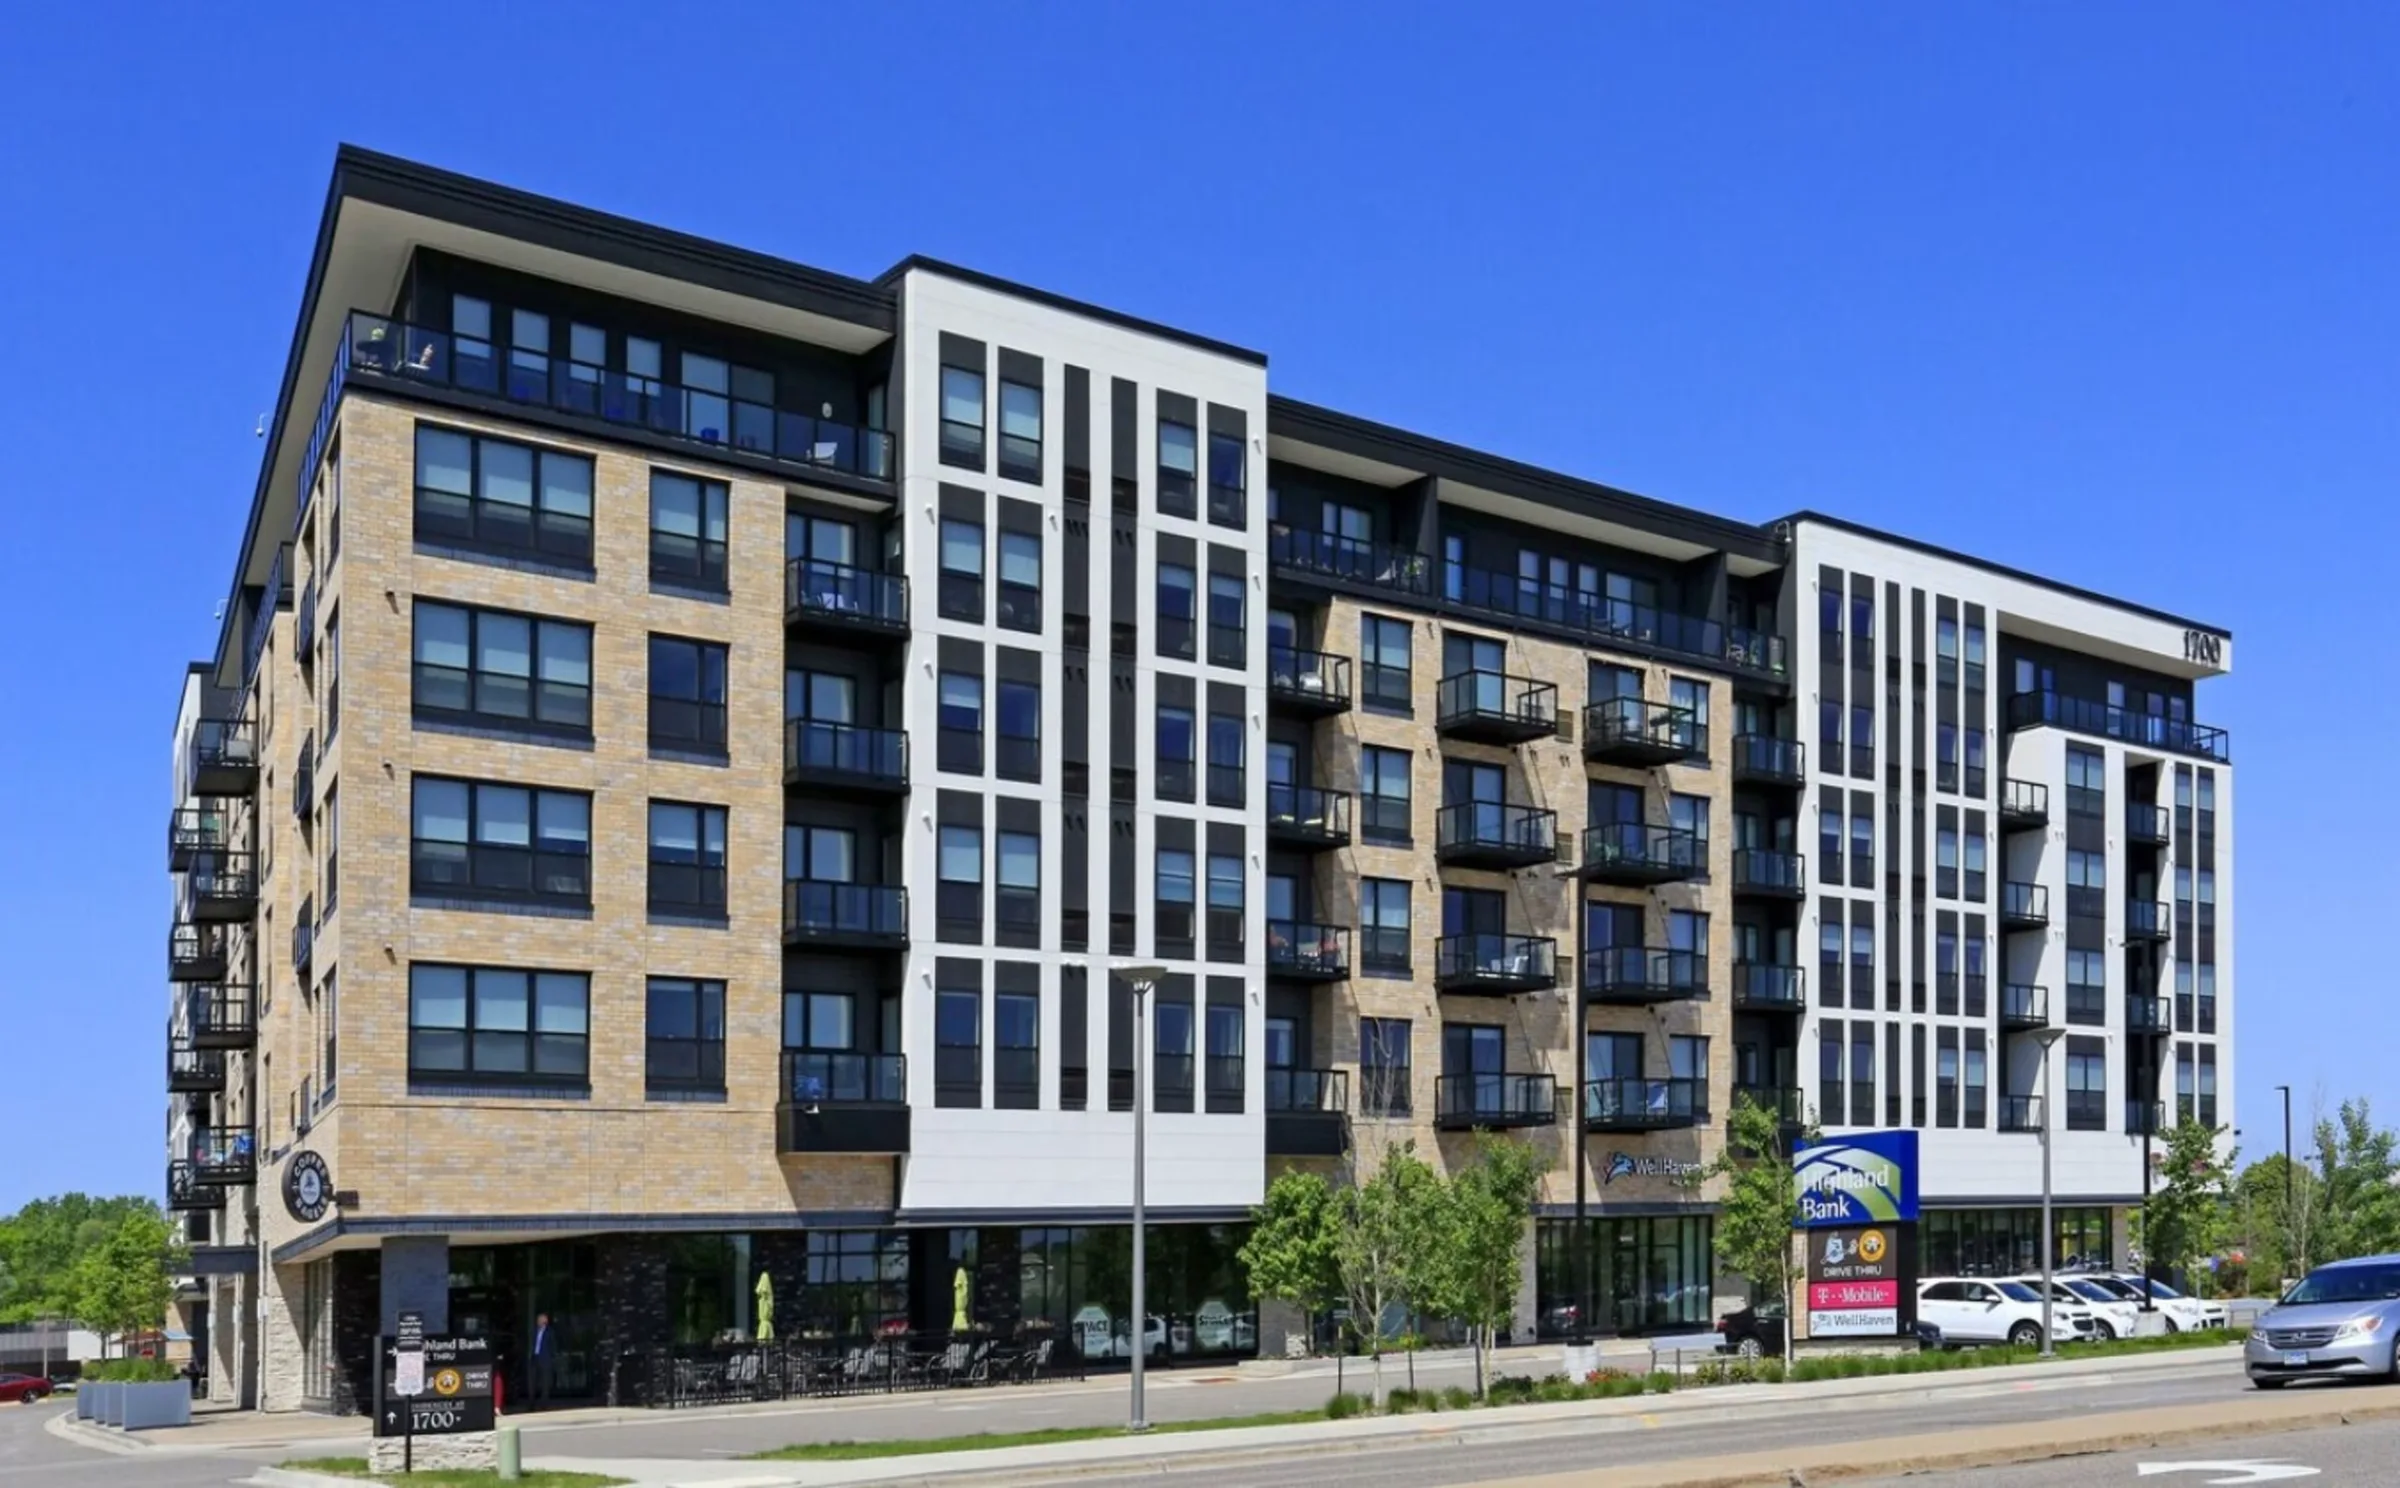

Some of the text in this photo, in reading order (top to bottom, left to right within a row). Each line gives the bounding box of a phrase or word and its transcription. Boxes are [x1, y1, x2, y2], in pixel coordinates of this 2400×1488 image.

[2184, 629, 2221, 664] 1700
[1802, 1195, 1850, 1219] Bank
[1823, 1264, 1882, 1277] DRIVE THRU
[1834, 1314, 1894, 1327] WellHaven
[459, 1338, 487, 1350] Bank
[412, 1411, 454, 1430] 1700
